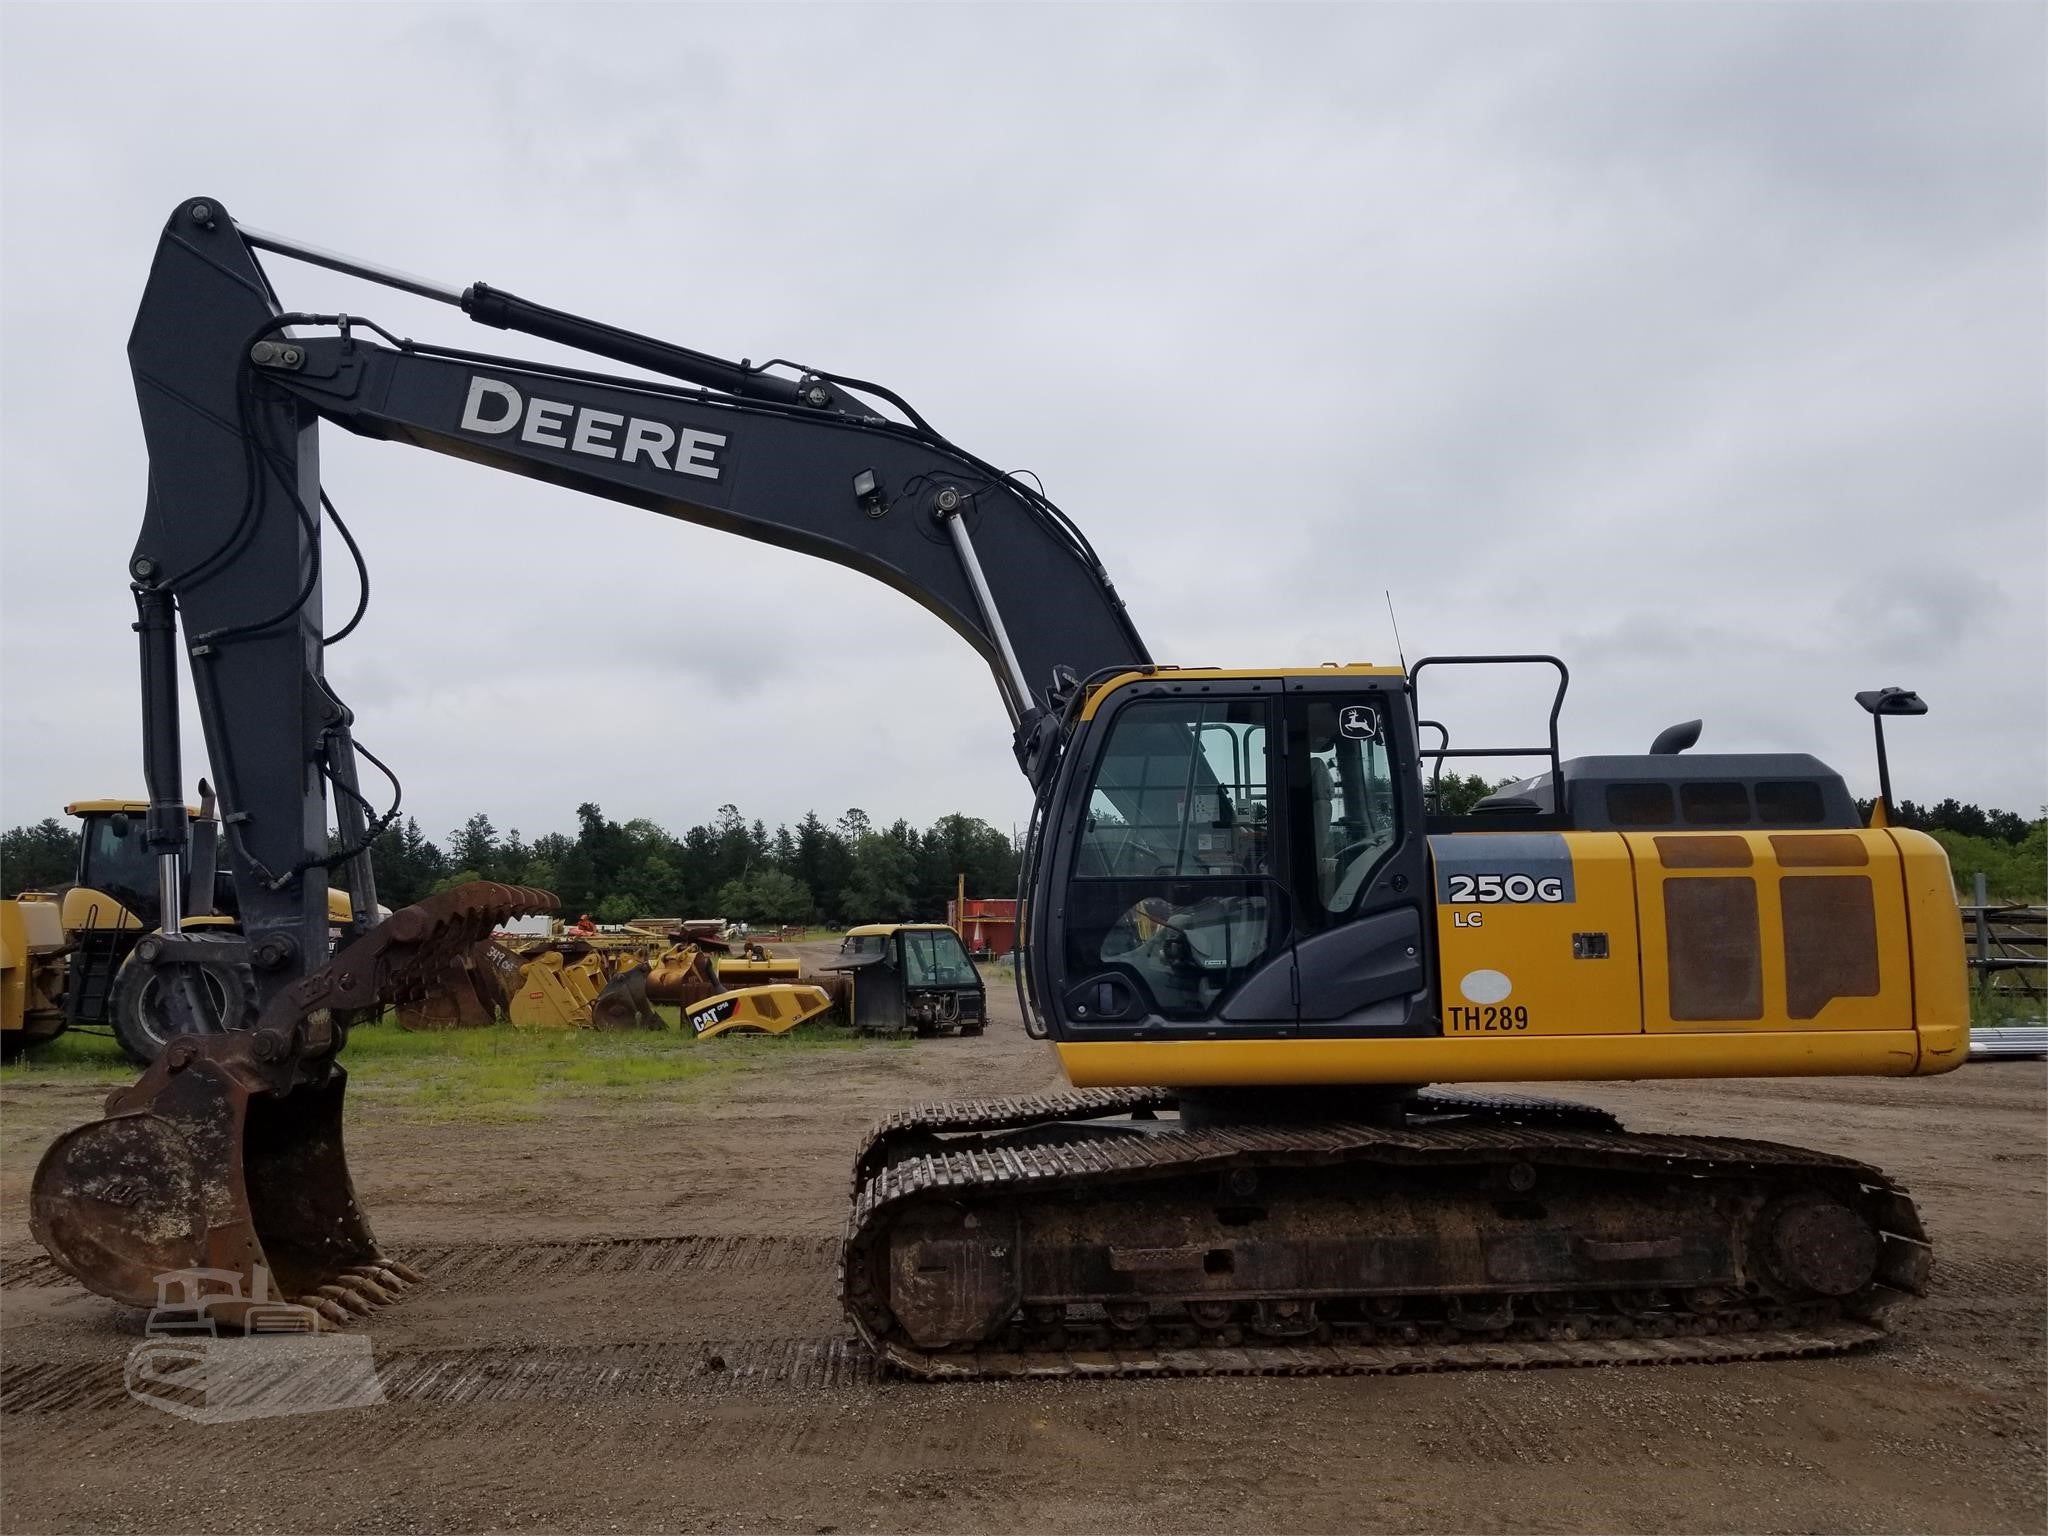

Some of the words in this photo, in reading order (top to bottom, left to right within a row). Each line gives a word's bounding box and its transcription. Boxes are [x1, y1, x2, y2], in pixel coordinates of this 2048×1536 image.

[460, 375, 727, 480] DEERE
[1449, 874, 1563, 903] 250G
[1453, 911, 1484, 928] LC
[693, 1008, 719, 1032] CAT
[1448, 1005, 1529, 1031] TH289
